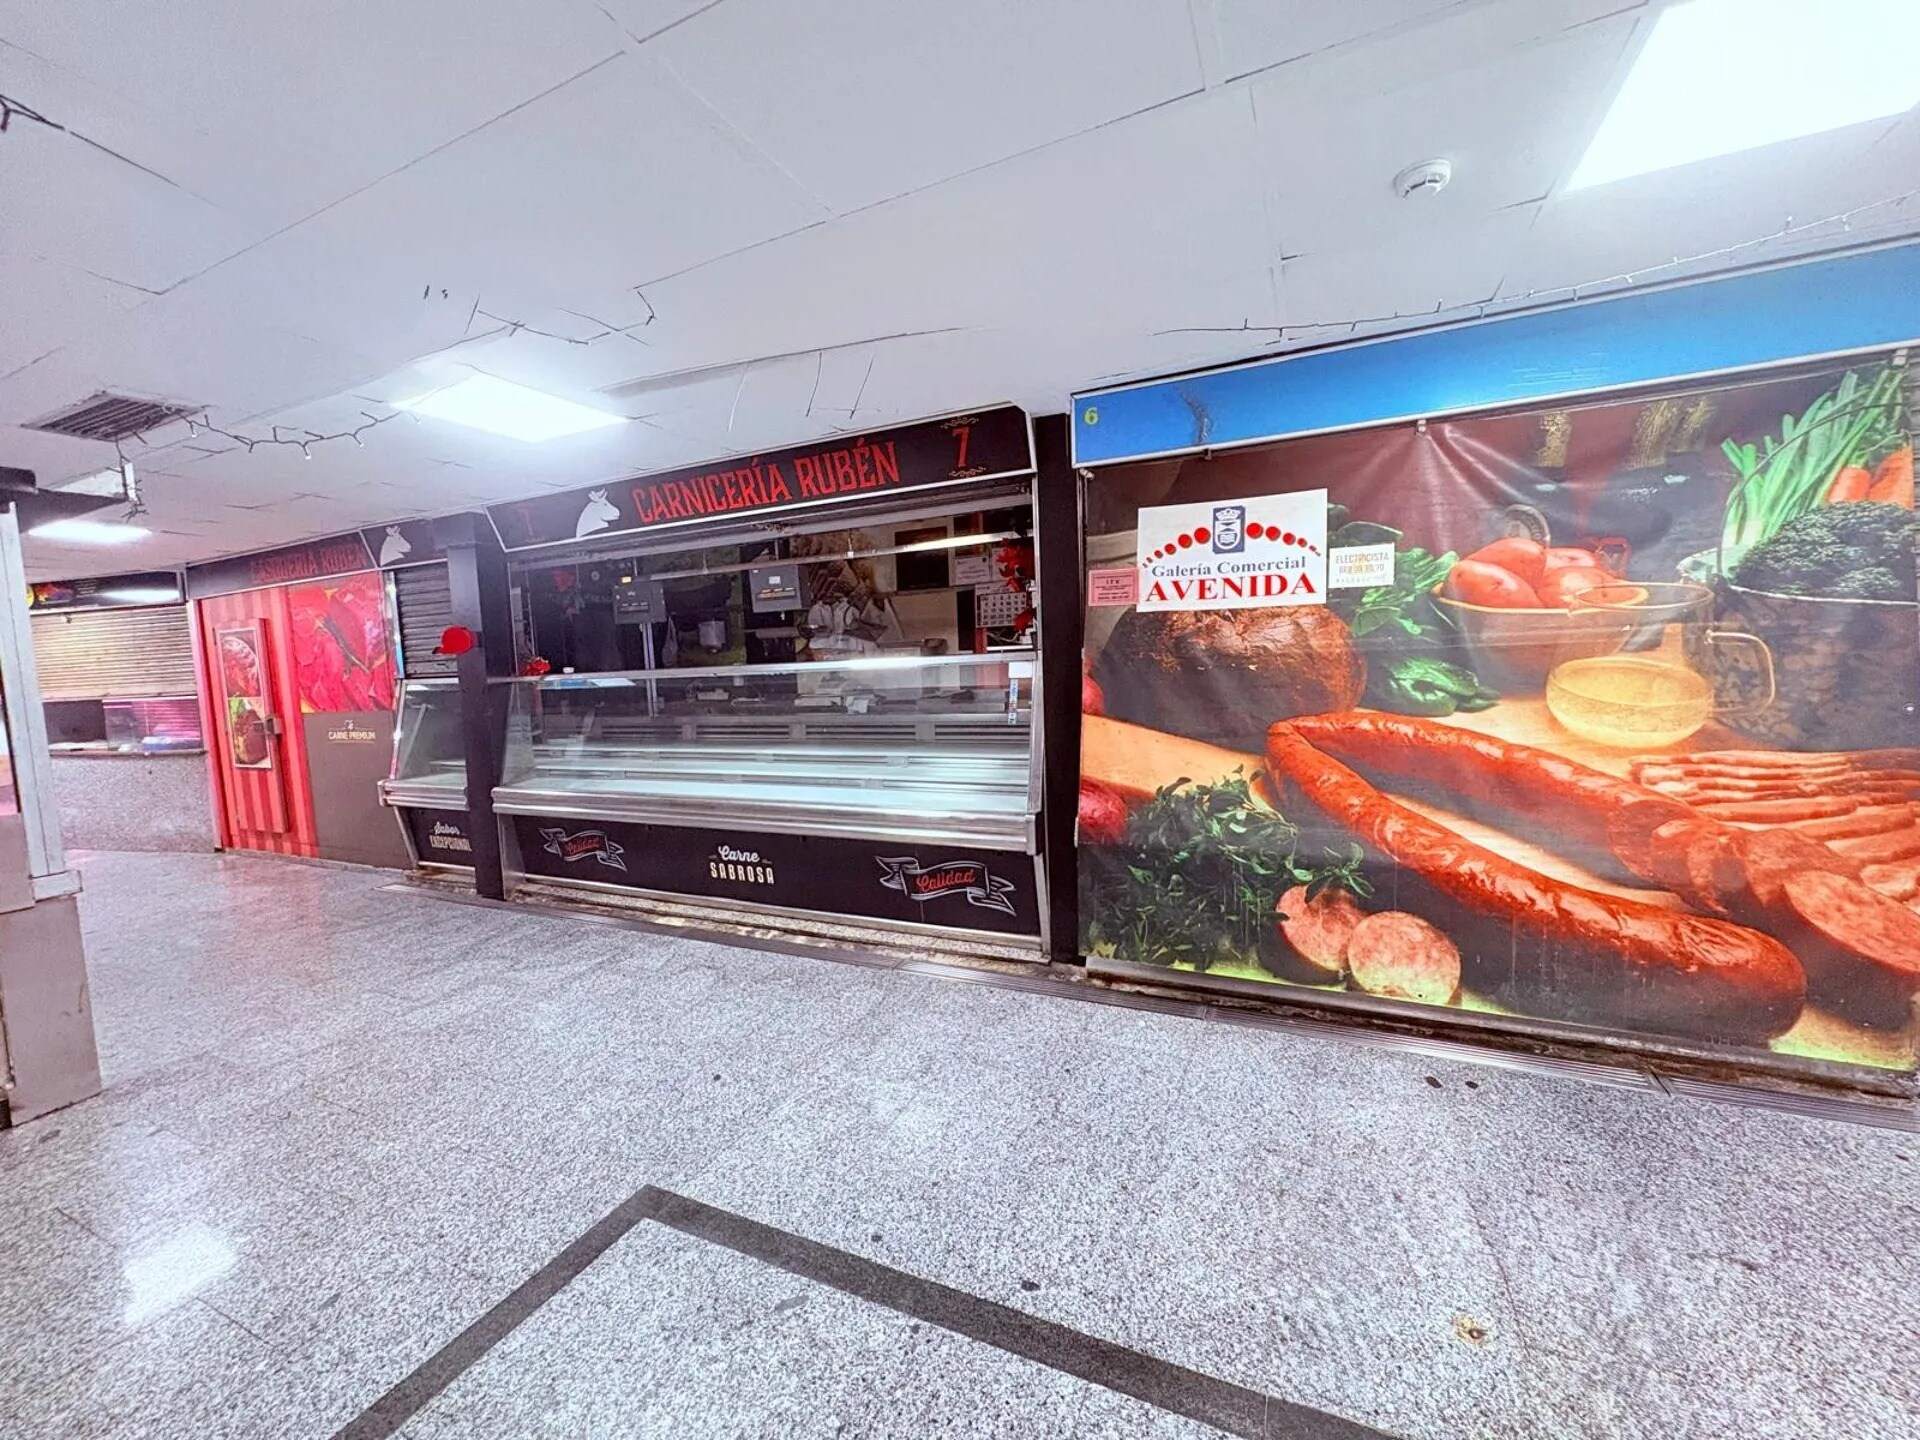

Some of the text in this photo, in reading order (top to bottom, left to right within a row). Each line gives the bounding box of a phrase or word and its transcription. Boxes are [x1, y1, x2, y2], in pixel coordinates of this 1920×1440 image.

[1084, 407, 1099, 425] 6
[952, 426, 971, 468] 7
[631, 437, 900, 525] CARNICERÍA RUBÉN
[1151, 556, 1306, 577] Galería Comercial
[1145, 572, 1317, 602] AVENIDA
[717, 845, 761, 863] Carne
[709, 861, 774, 884] SABROSA
[916, 868, 976, 893] Calidad
